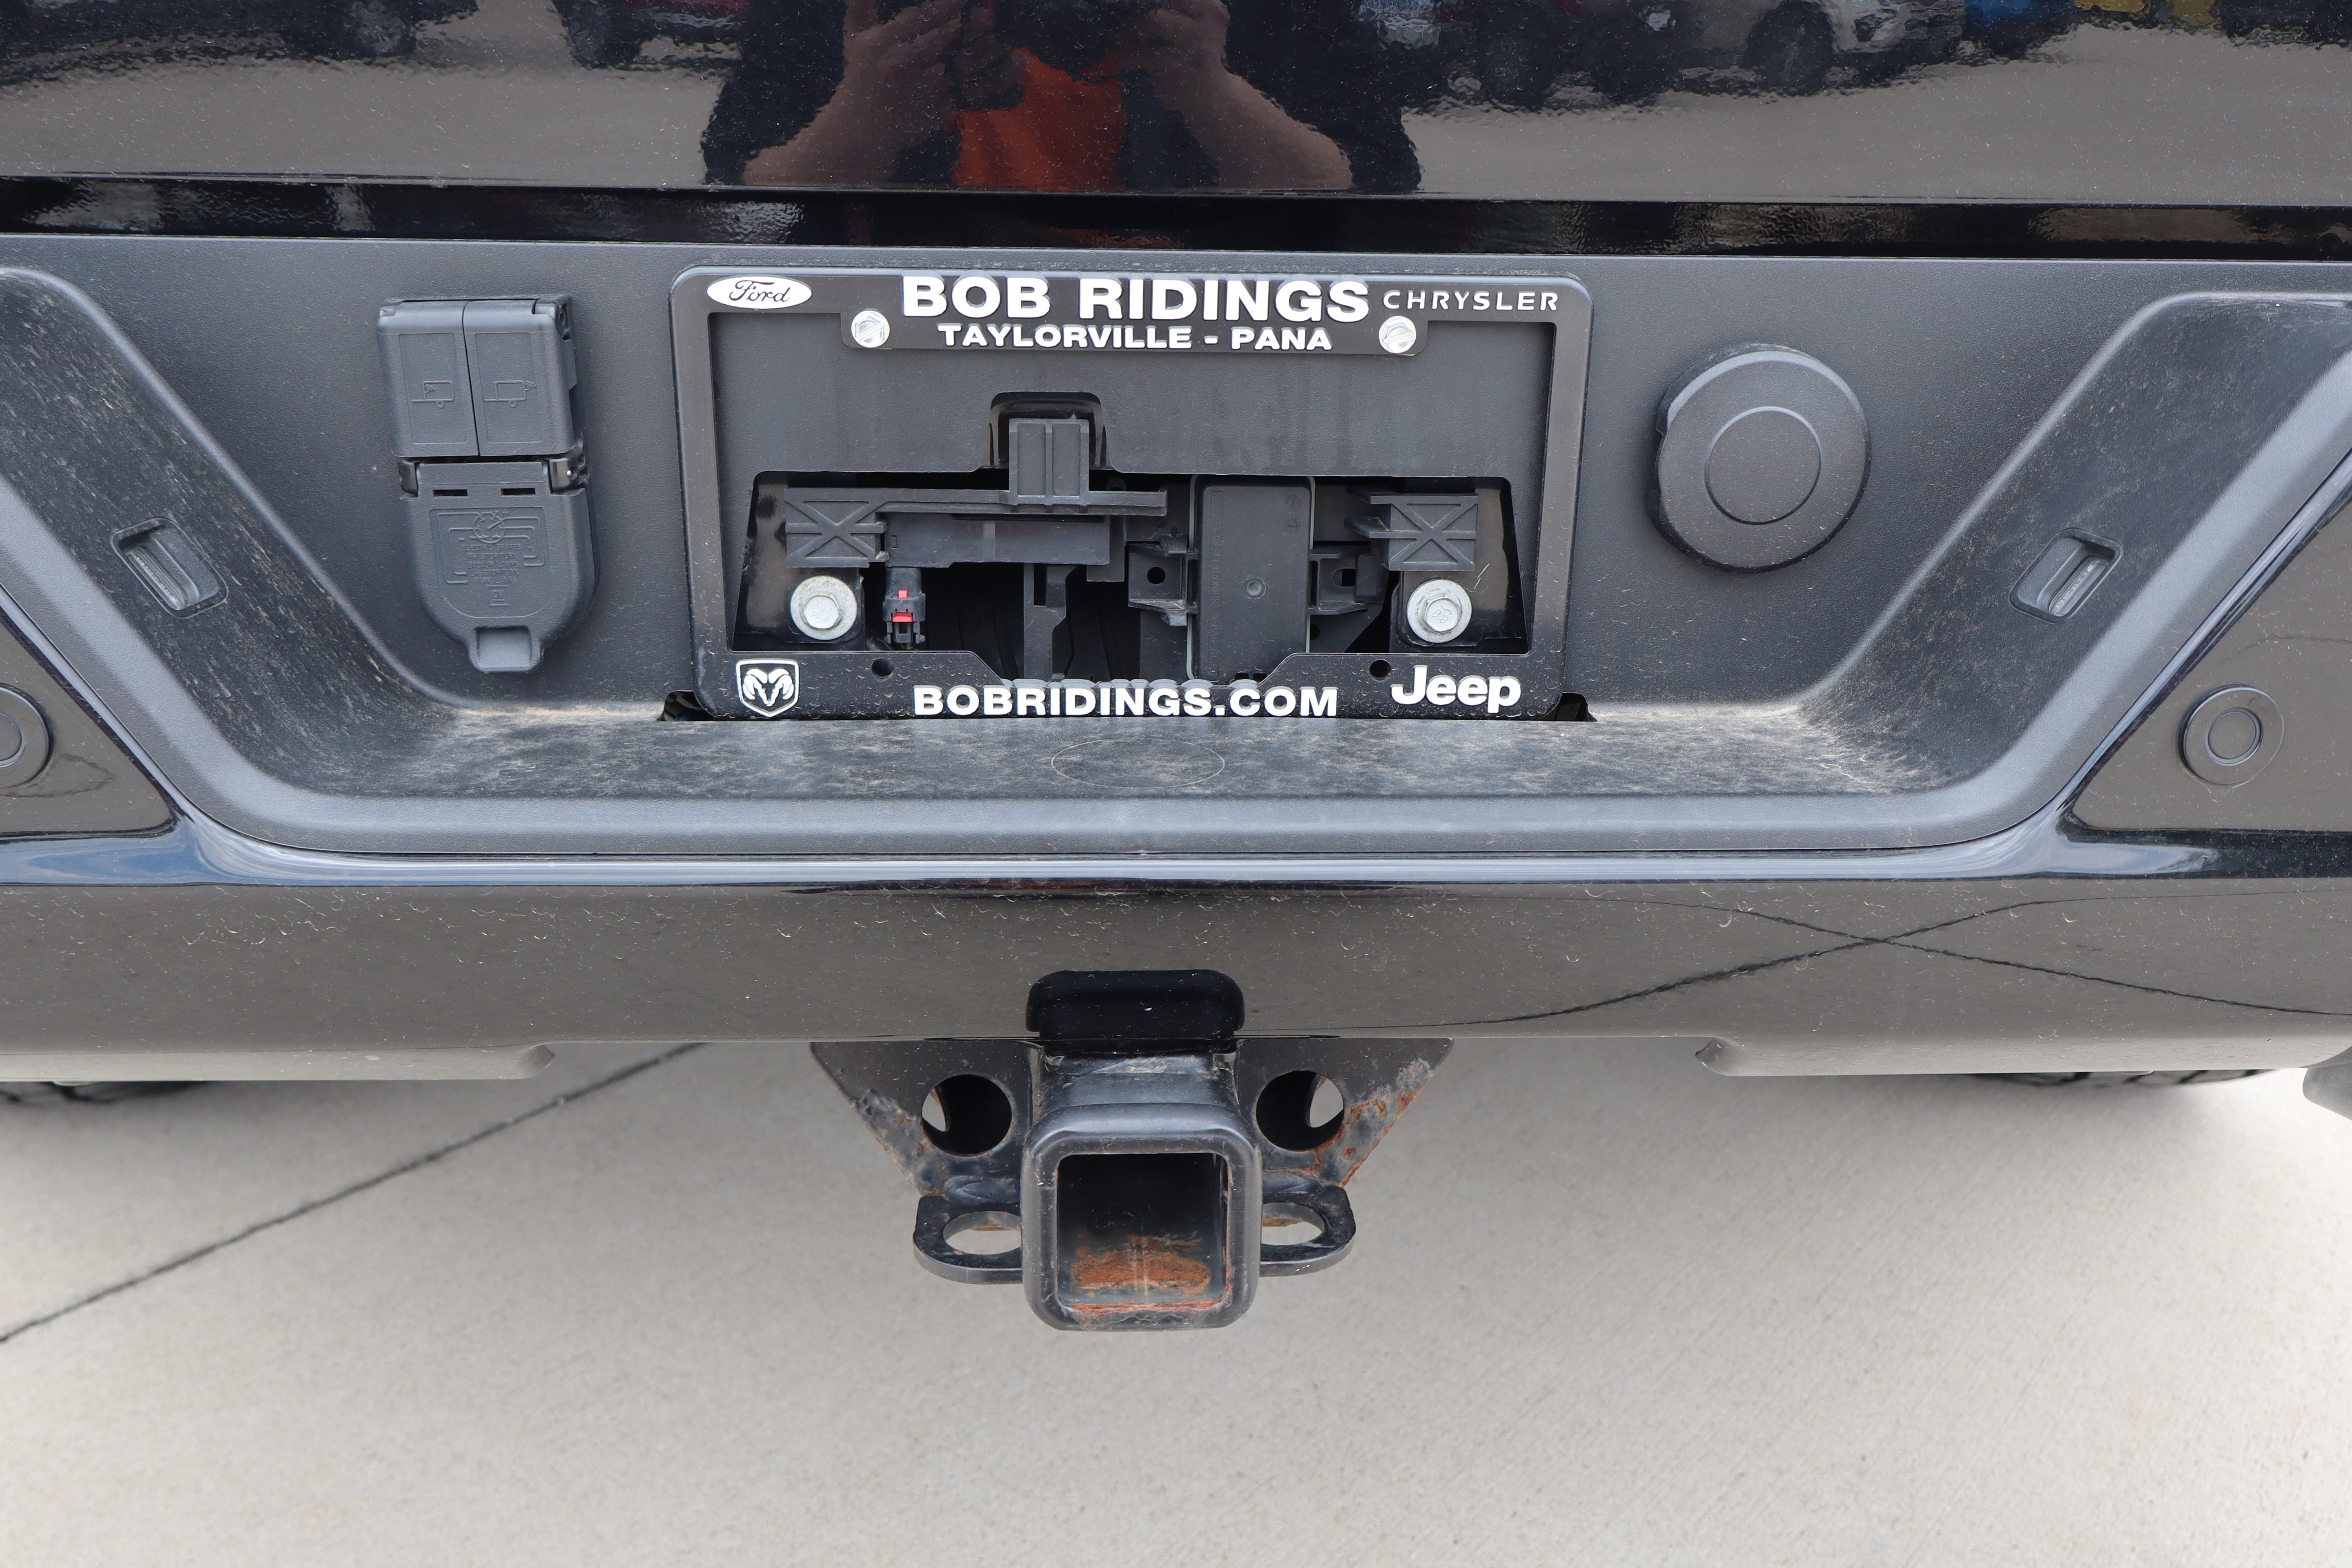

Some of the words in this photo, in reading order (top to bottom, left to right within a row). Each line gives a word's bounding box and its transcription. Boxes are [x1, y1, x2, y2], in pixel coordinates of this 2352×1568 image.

[729, 280, 791, 302] Ford
[902, 274, 1051, 318] BOB
[1079, 276, 1369, 323] RIDINGS
[1383, 290, 1558, 311] CHRYSLER
[938, 323, 1192, 349] TAYLORVILLE
[1230, 327, 1333, 350] PANA
[913, 684, 1339, 716] BOBRIDINGS.COM
[1390, 665, 1521, 713] Jeep
